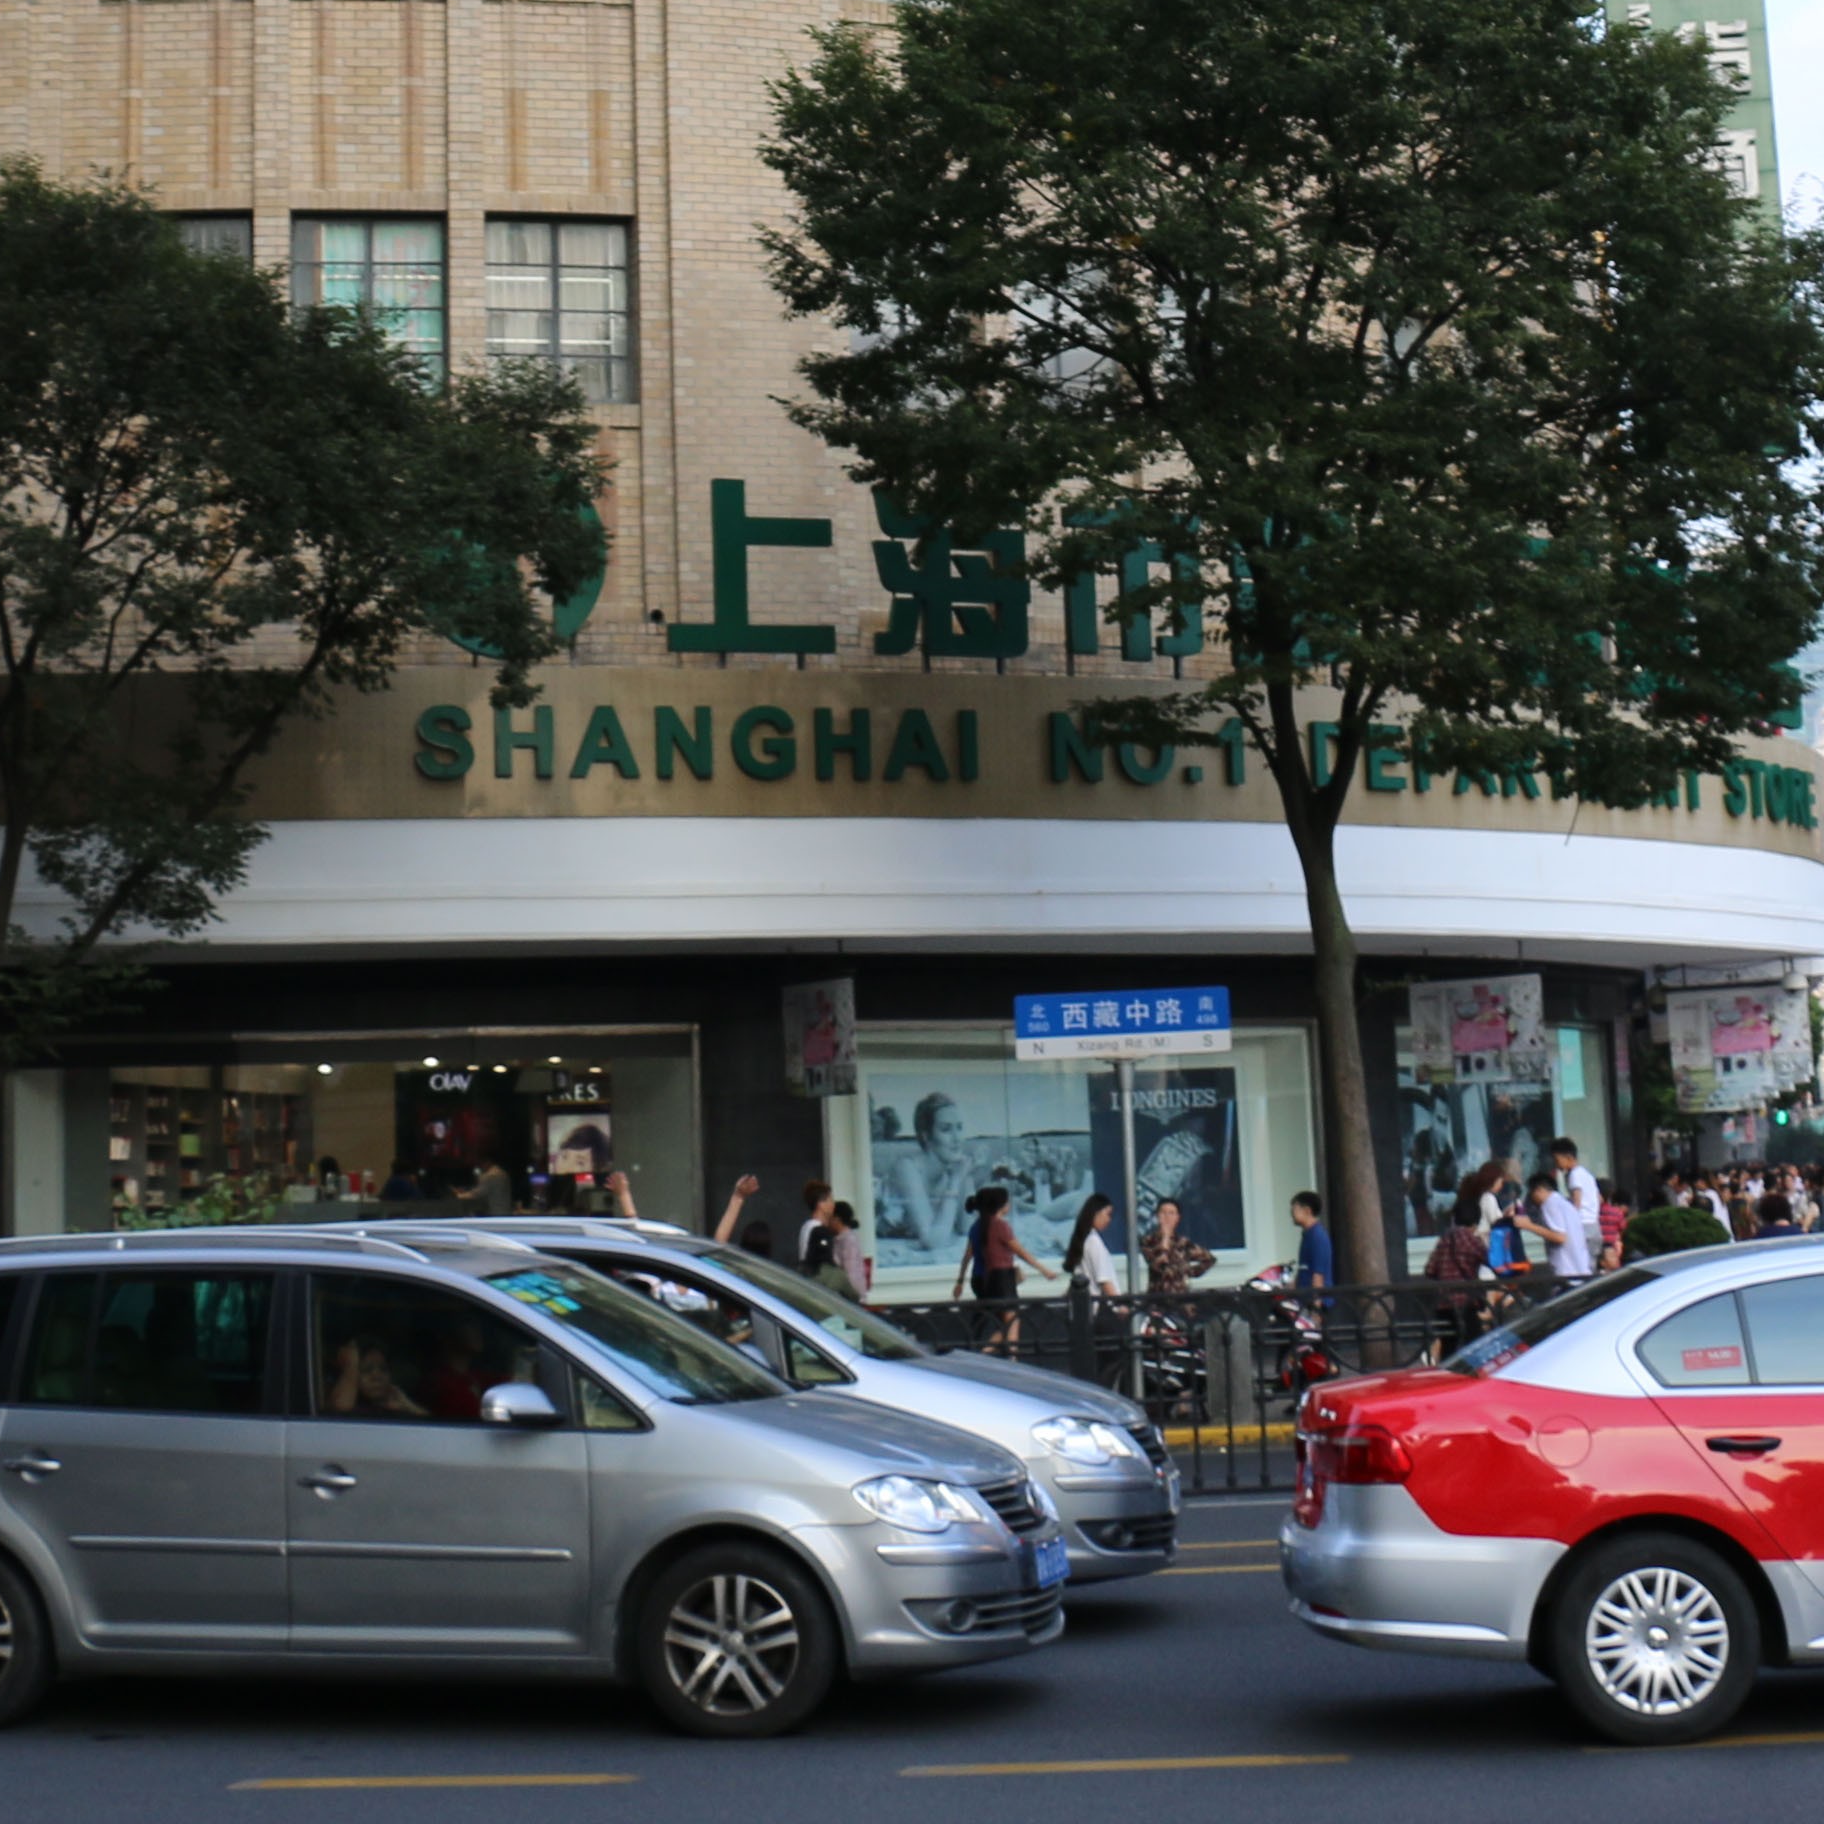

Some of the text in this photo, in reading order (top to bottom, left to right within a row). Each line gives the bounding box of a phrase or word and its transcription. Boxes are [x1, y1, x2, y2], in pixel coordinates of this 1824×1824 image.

[413, 704, 979, 782] SHANGHAI
[1061, 998, 1183, 1030] 西藏中路
[1033, 1042, 1044, 1054] N
[1203, 1035, 1213, 1047] S
